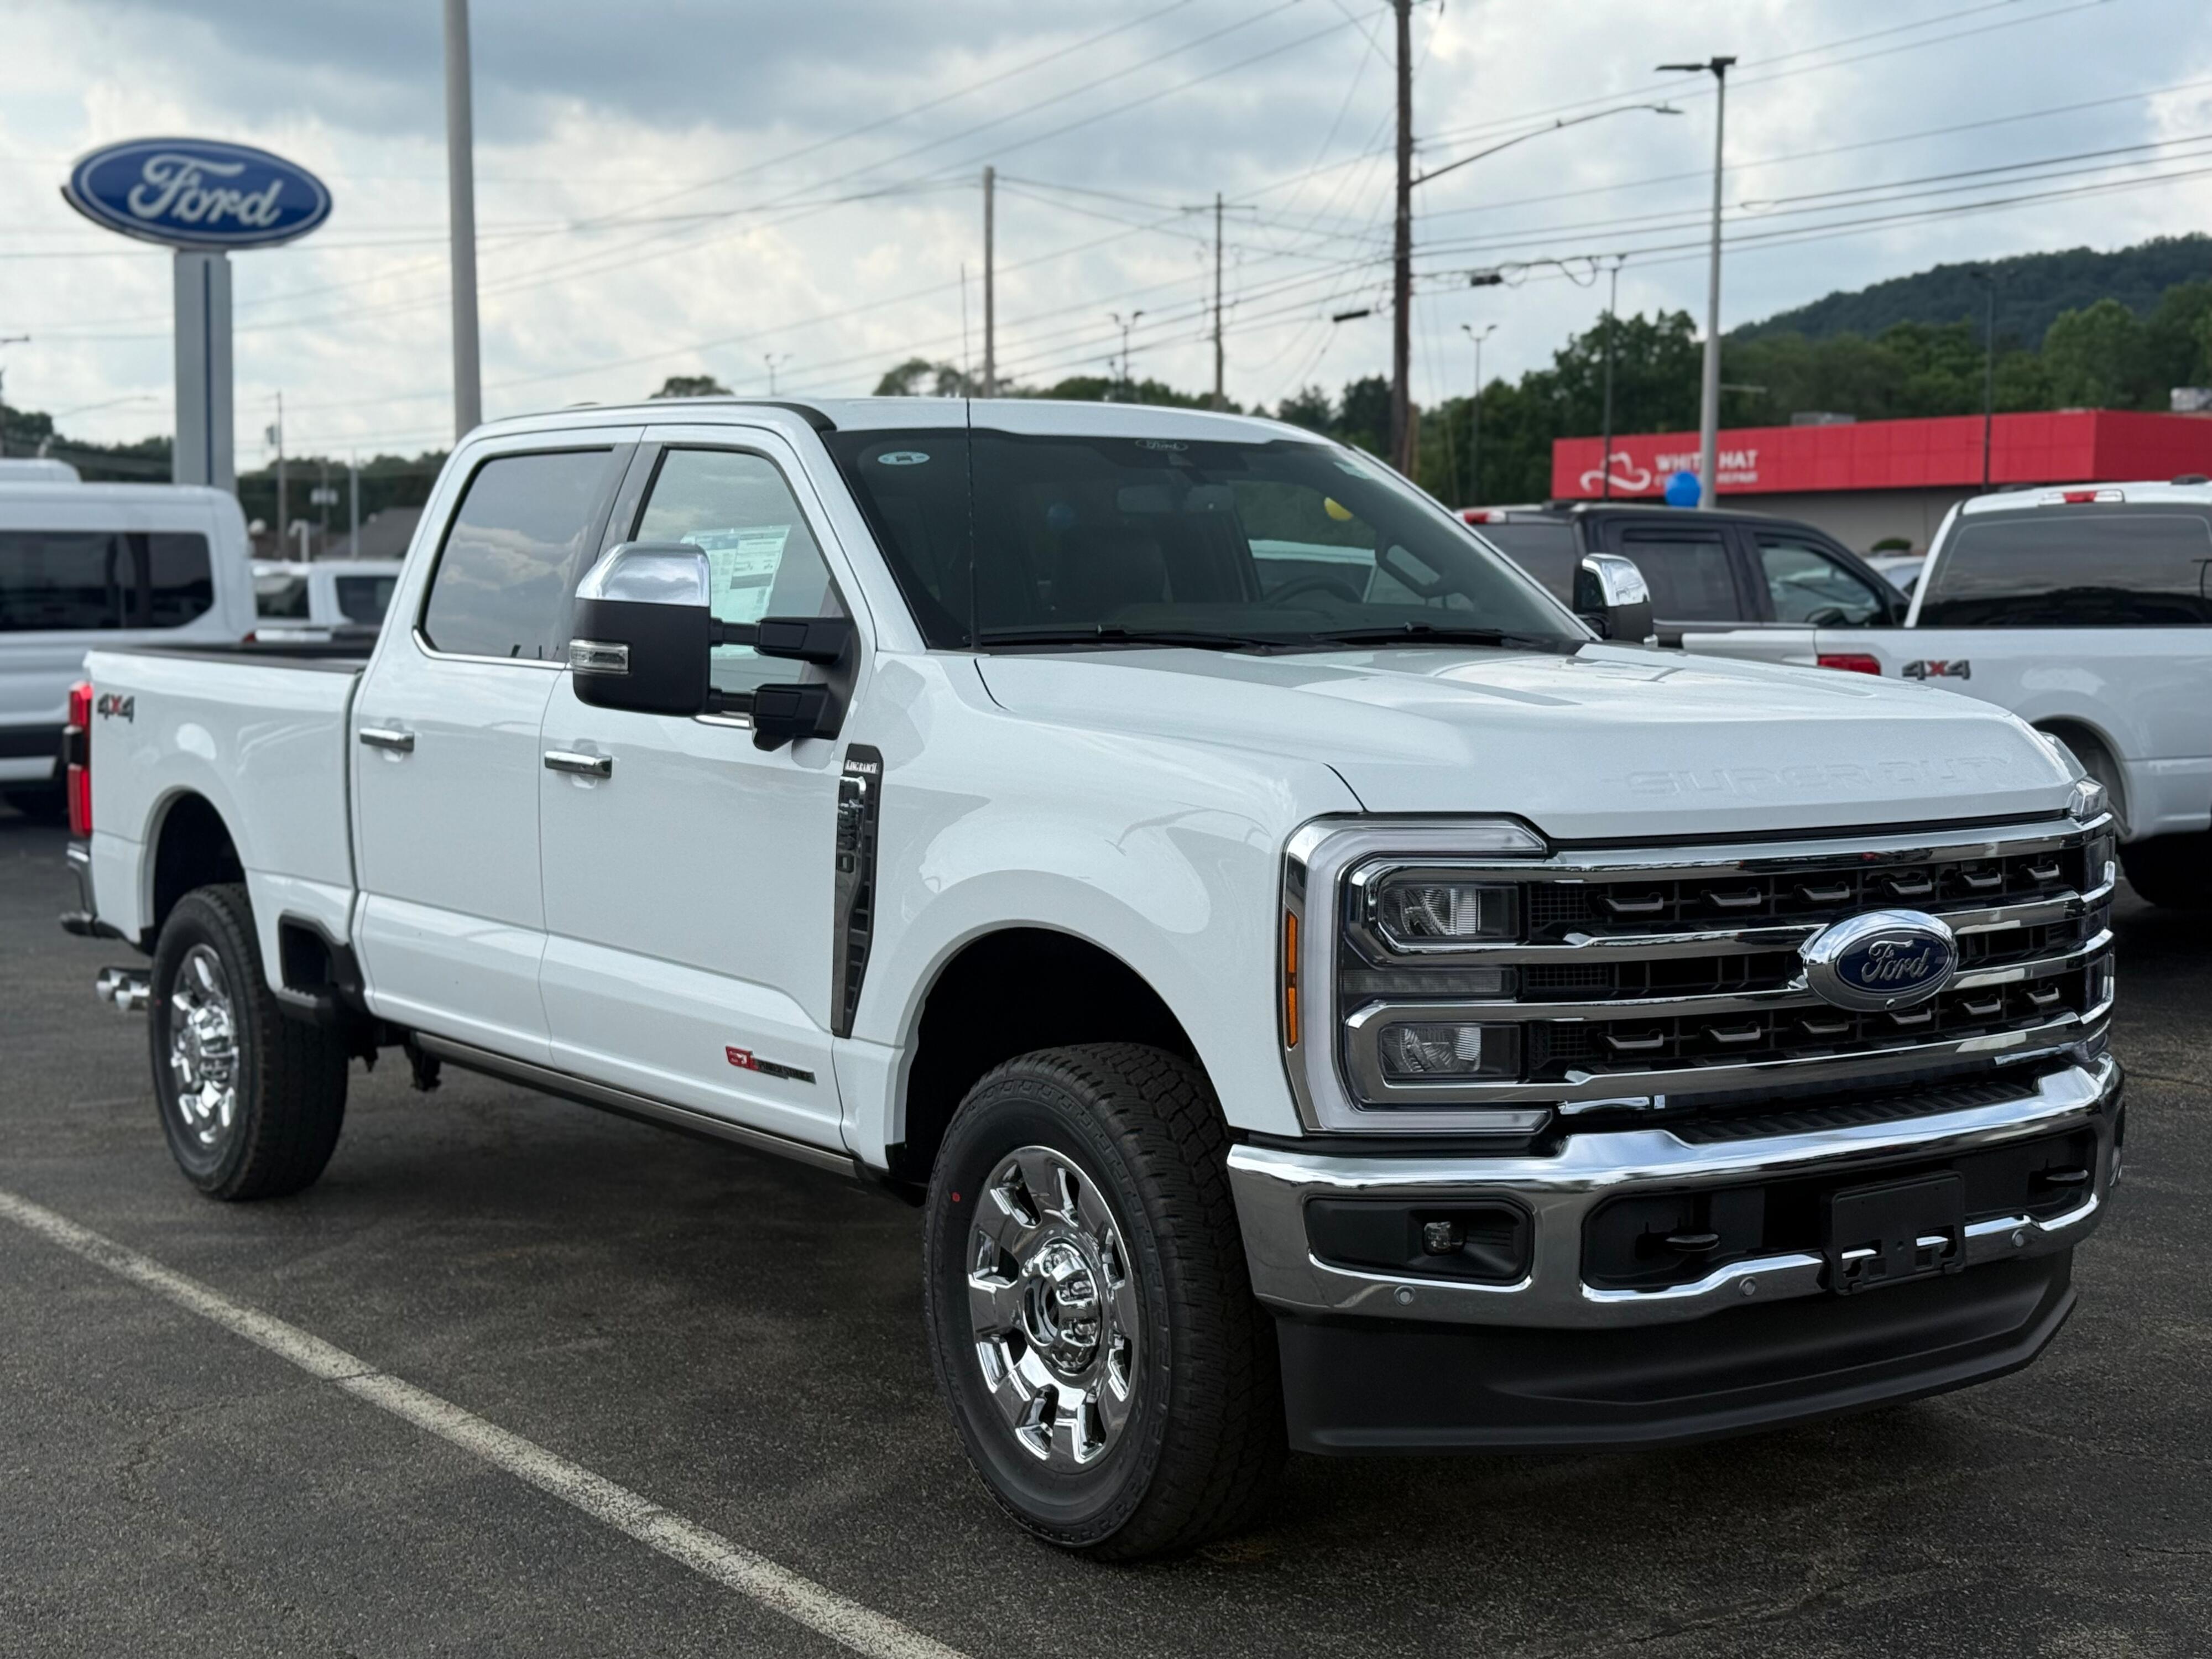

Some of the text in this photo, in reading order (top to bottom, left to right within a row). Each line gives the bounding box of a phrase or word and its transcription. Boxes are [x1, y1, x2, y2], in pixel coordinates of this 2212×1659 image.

[128, 153, 283, 226] Ford
[1655, 450, 1758, 472] WHIT HAT
[1626, 757, 2012, 796] SUPER DUTY
[1861, 940, 1930, 983] Ford
